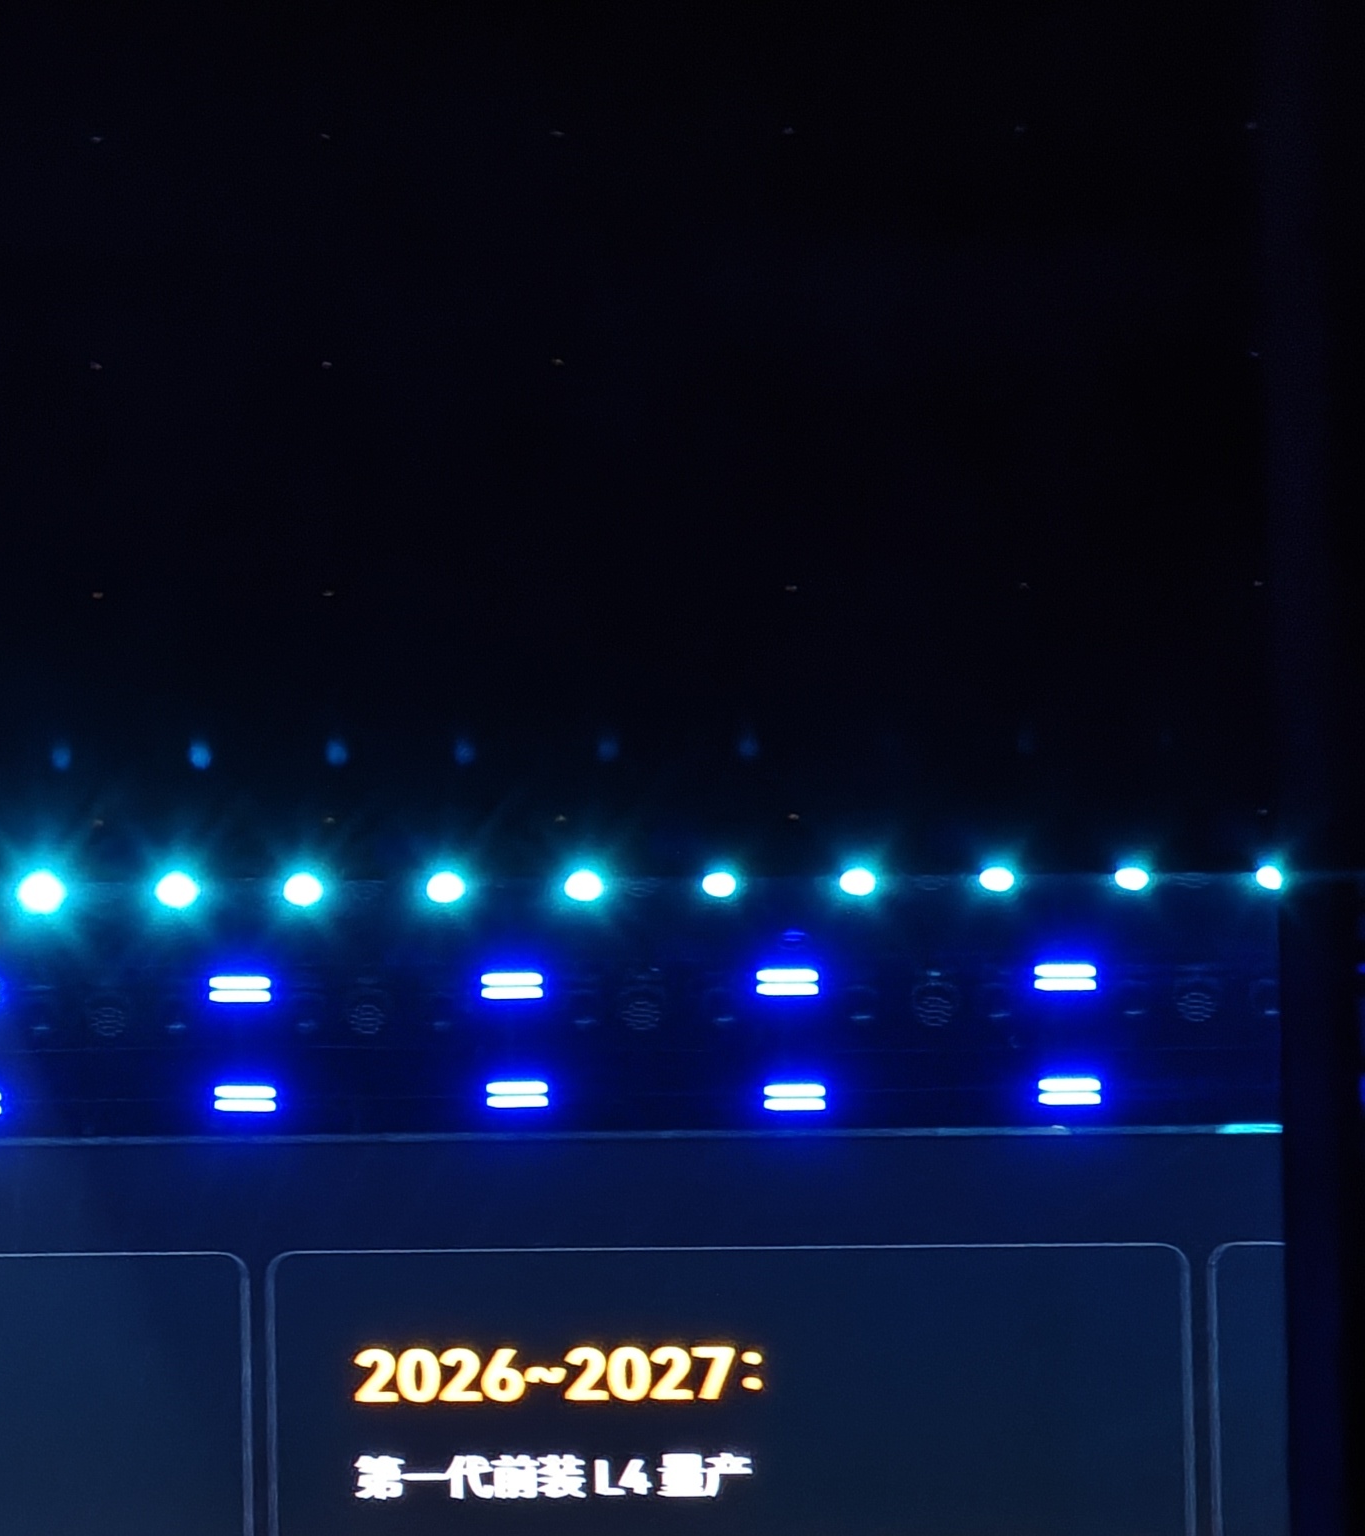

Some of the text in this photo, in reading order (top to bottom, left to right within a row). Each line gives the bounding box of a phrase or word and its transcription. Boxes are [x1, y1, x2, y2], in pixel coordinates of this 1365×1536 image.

[353, 1452, 753, 1501] 第一代前装 L4 量产
